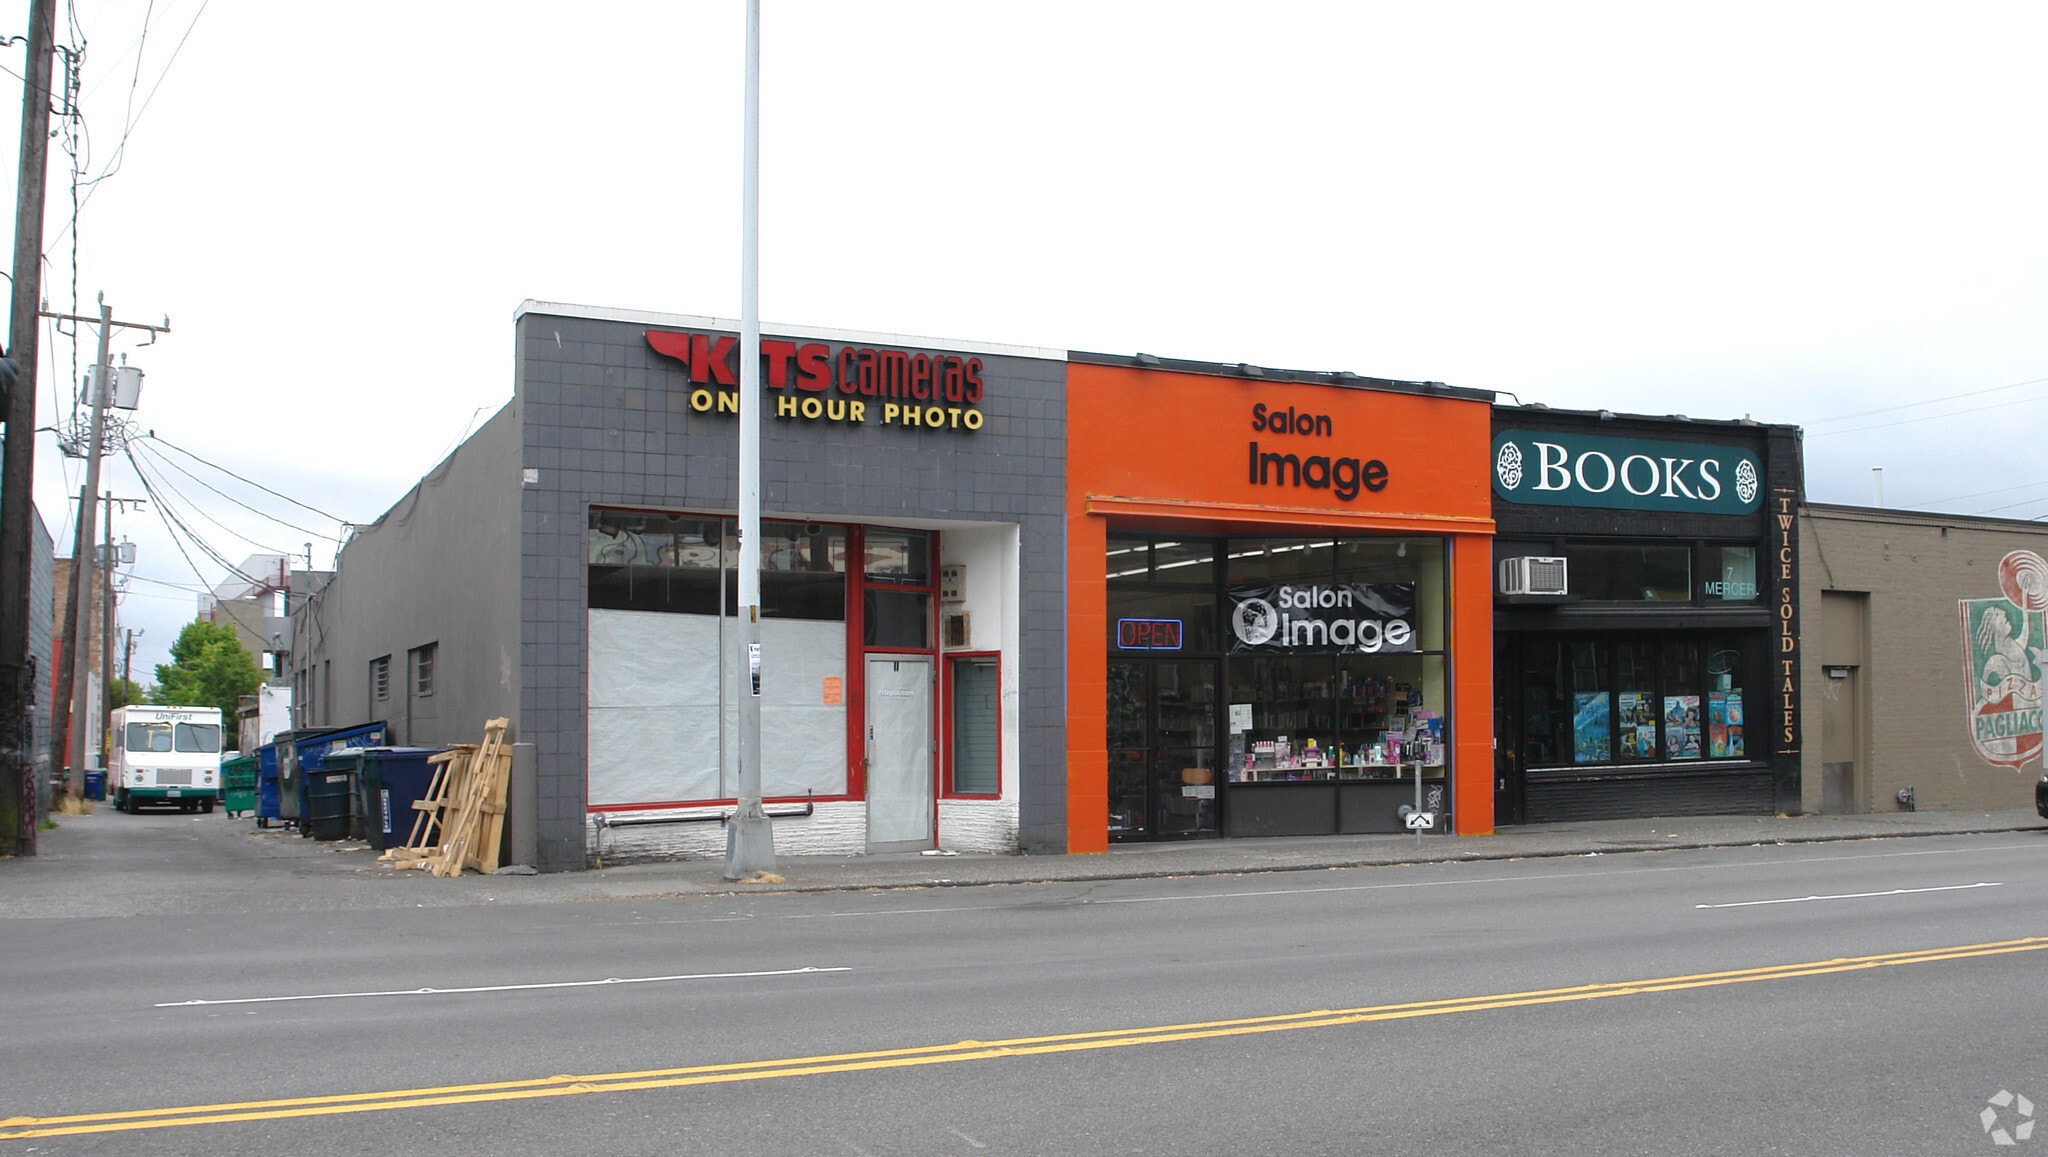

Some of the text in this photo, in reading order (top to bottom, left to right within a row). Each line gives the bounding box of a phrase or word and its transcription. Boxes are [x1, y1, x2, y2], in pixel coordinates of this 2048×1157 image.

[691, 333, 984, 404] KTS cameras
[690, 388, 984, 430] ON HOUR PHOTO
[1252, 403, 1333, 438] Salon
[1249, 441, 1389, 502] Image
[1532, 442, 1721, 501] BOOKS
[1726, 566, 1734, 580] 7
[1279, 583, 1353, 609] Salon
[1120, 621, 1180, 647] OPEN
[1281, 612, 1411, 653] Image
[1777, 498, 1794, 743] TWICE SOLD TALES
[1986, 676, 2037, 699] PIZZA
[155, 712, 193, 721] UniFirst
[1976, 709, 2043, 740] PAGLIACC
